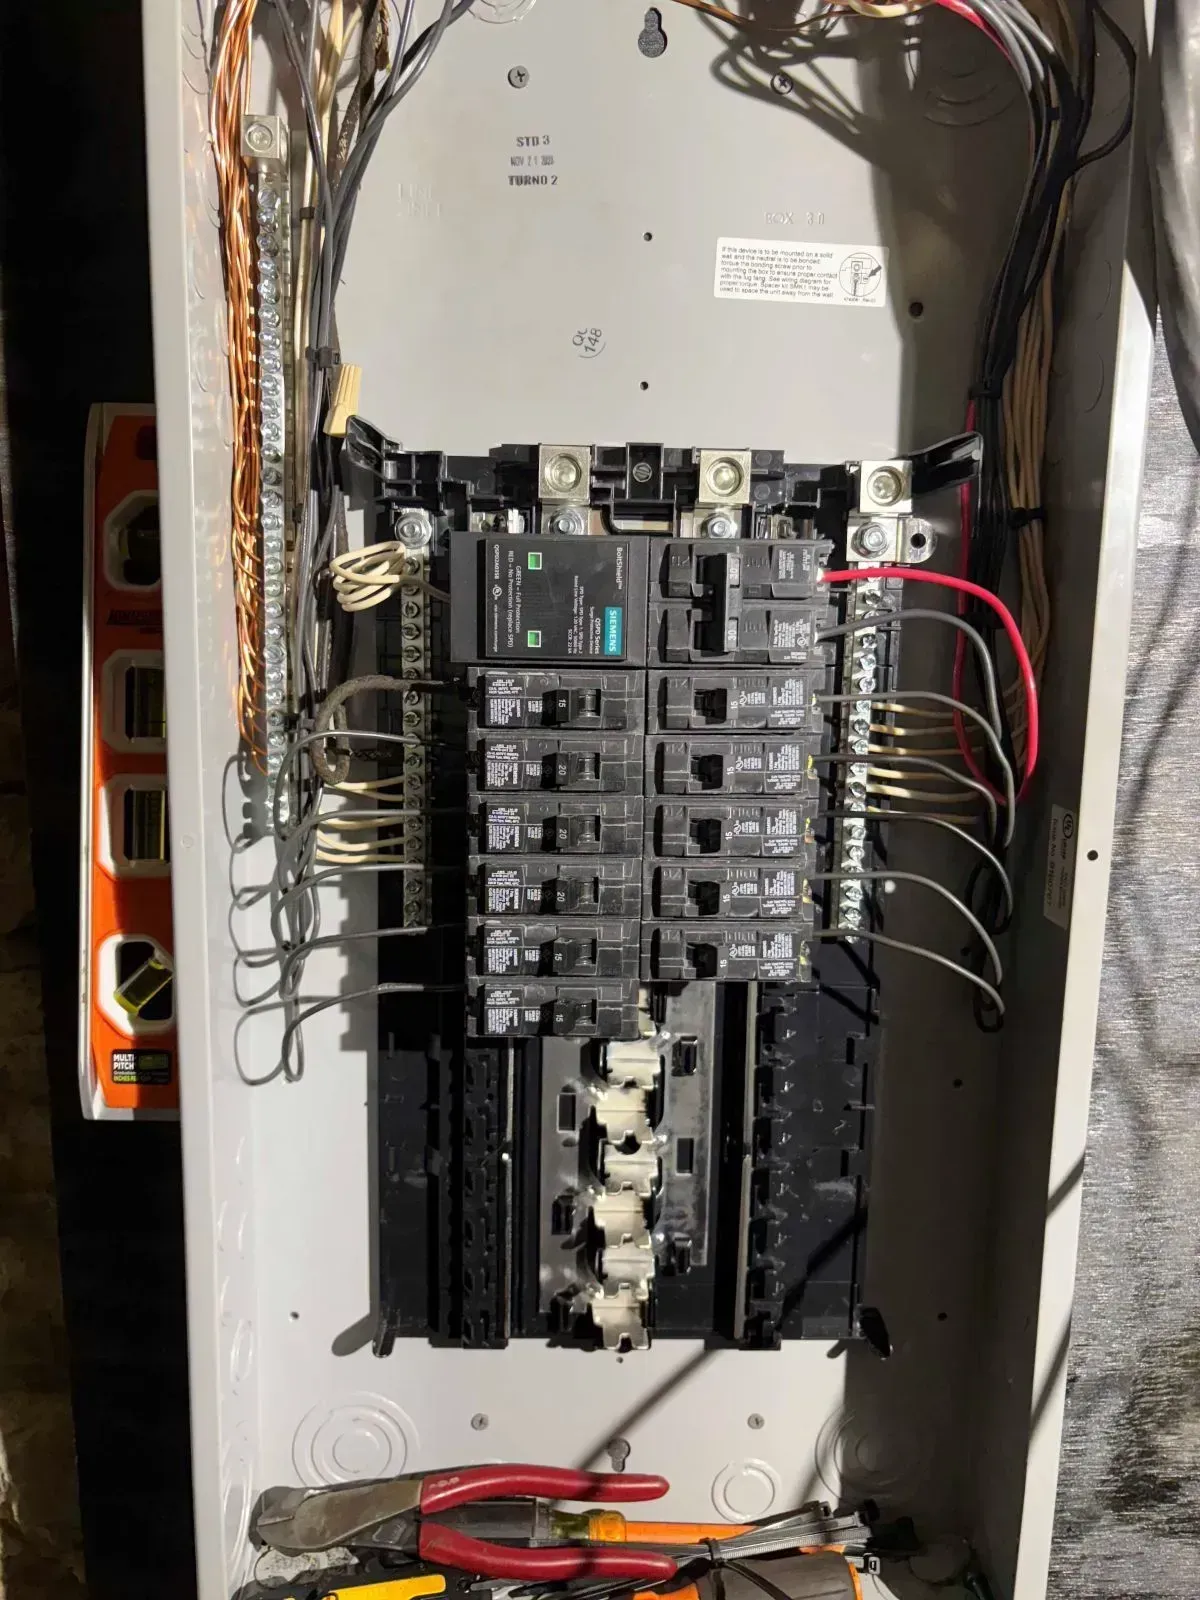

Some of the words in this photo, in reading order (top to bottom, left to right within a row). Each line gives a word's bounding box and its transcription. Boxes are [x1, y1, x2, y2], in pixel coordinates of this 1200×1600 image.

[516, 136, 540, 147] STD
[542, 134, 550, 145] 3
[508, 175, 548, 186] TURNO
[551, 174, 558, 185] 2
[584, 328, 602, 352] 148
[730, 568, 737, 580] 30
[609, 610, 617, 652] SIEMENS
[728, 630, 736, 641] 30
[559, 699, 566, 708] 15
[731, 701, 738, 709] 15
[558, 764, 567, 776] 20
[727, 766, 734, 775] 15
[559, 828, 567, 840] 20
[725, 831, 732, 840] 15
[557, 892, 565, 902] 20
[723, 894, 730, 902] 15
[555, 952, 562, 961] 15
[720, 959, 727, 968] 15
[555, 1014, 563, 1022] 15
[113, 1062, 134, 1070] PITCH
